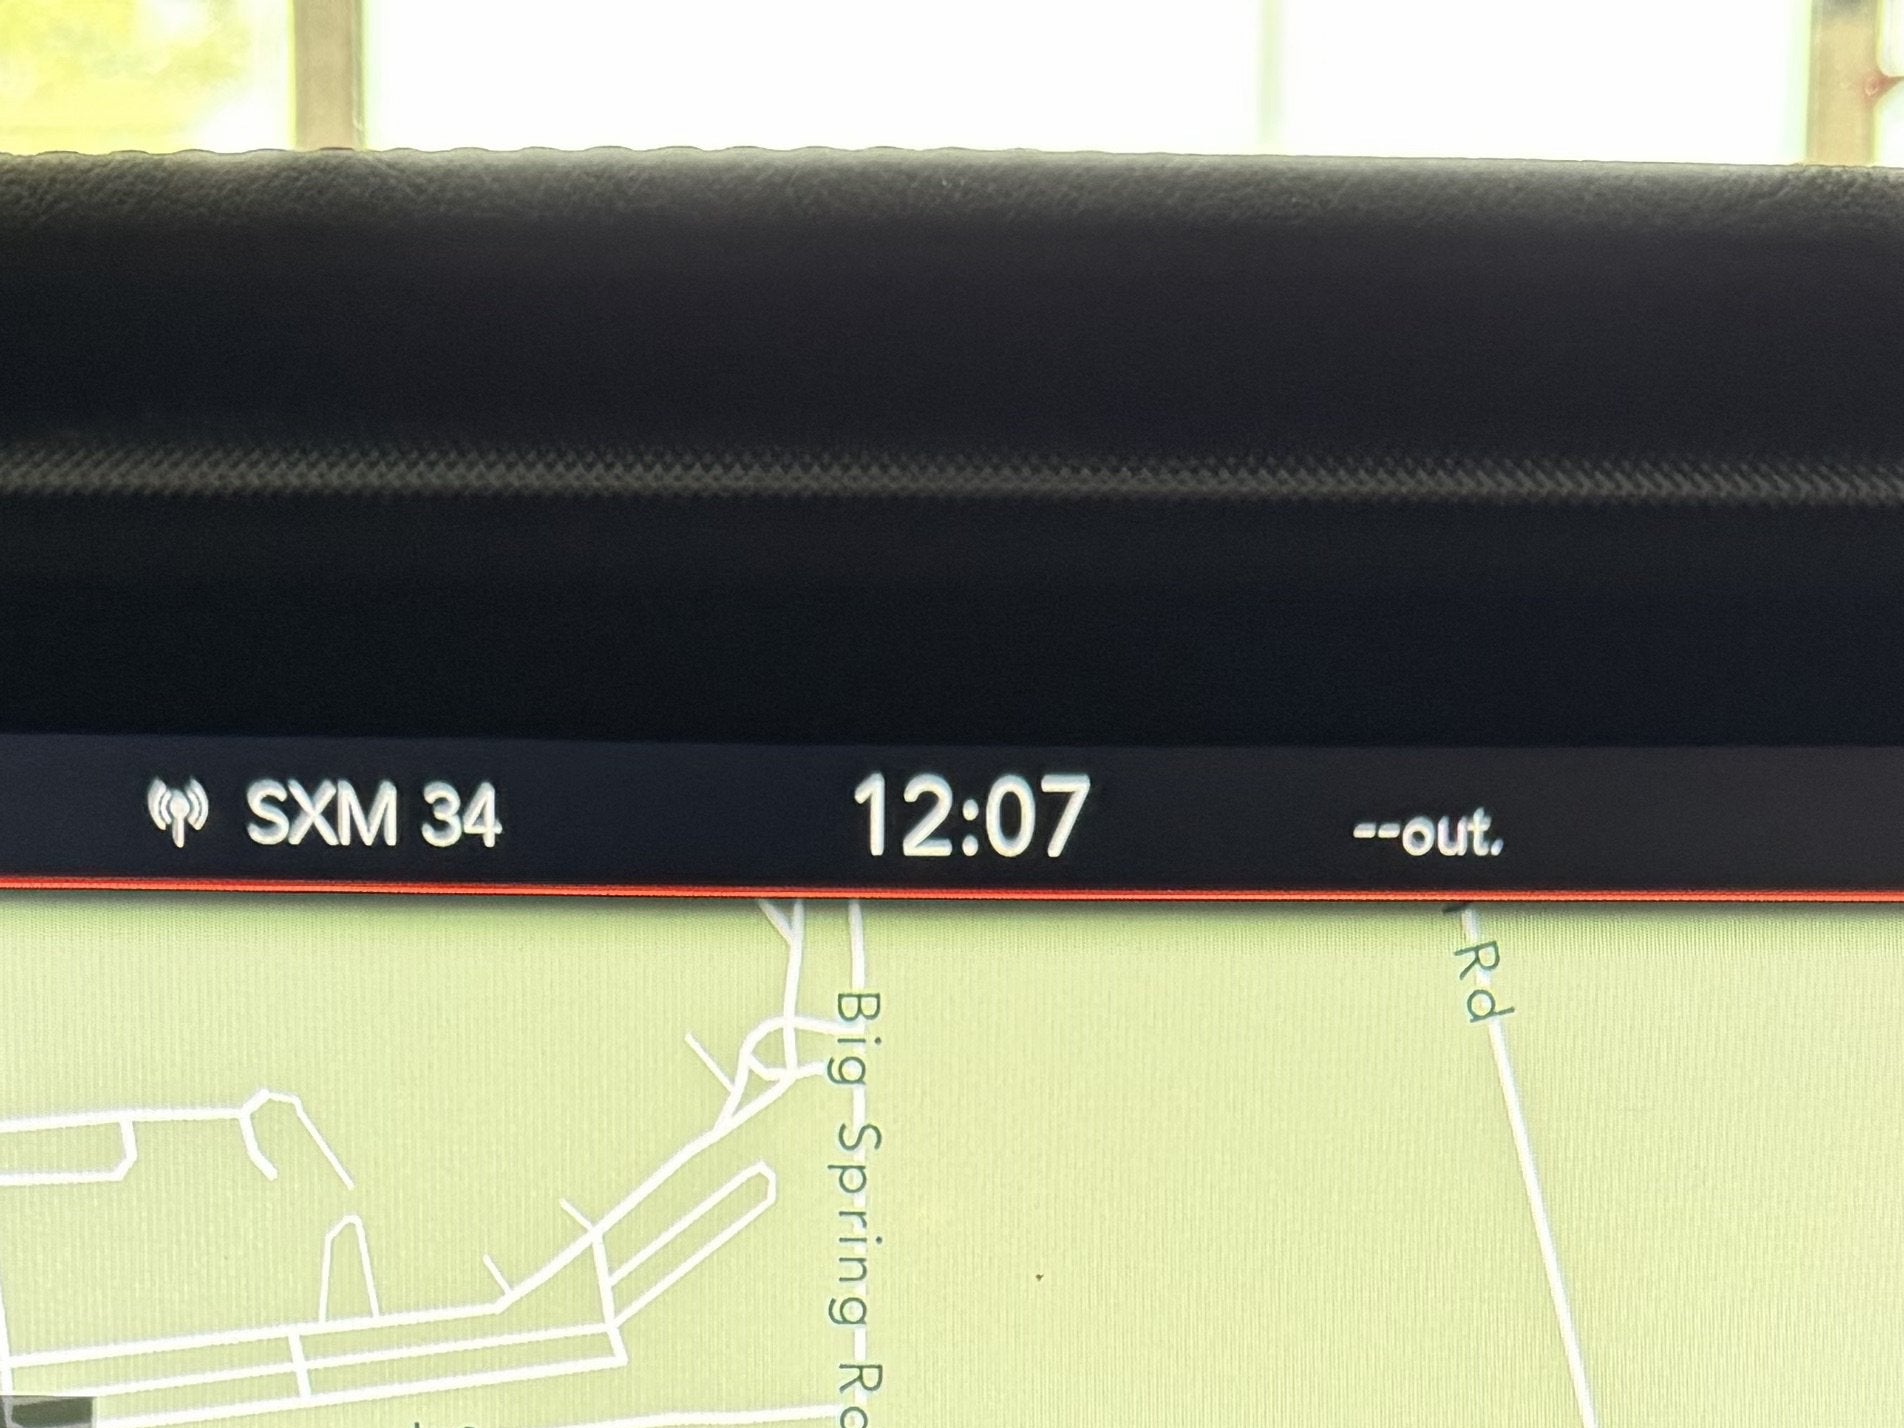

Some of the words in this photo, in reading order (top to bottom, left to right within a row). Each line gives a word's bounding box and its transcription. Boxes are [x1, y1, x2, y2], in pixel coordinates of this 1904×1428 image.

[248, 781, 396, 847] SXM
[421, 782, 502, 849] 34
[853, 772, 1092, 858] 12:07
[1453, 939, 1516, 1024] Rd
[827, 992, 882, 1086] Big
[828, 1122, 883, 1326] Spring
